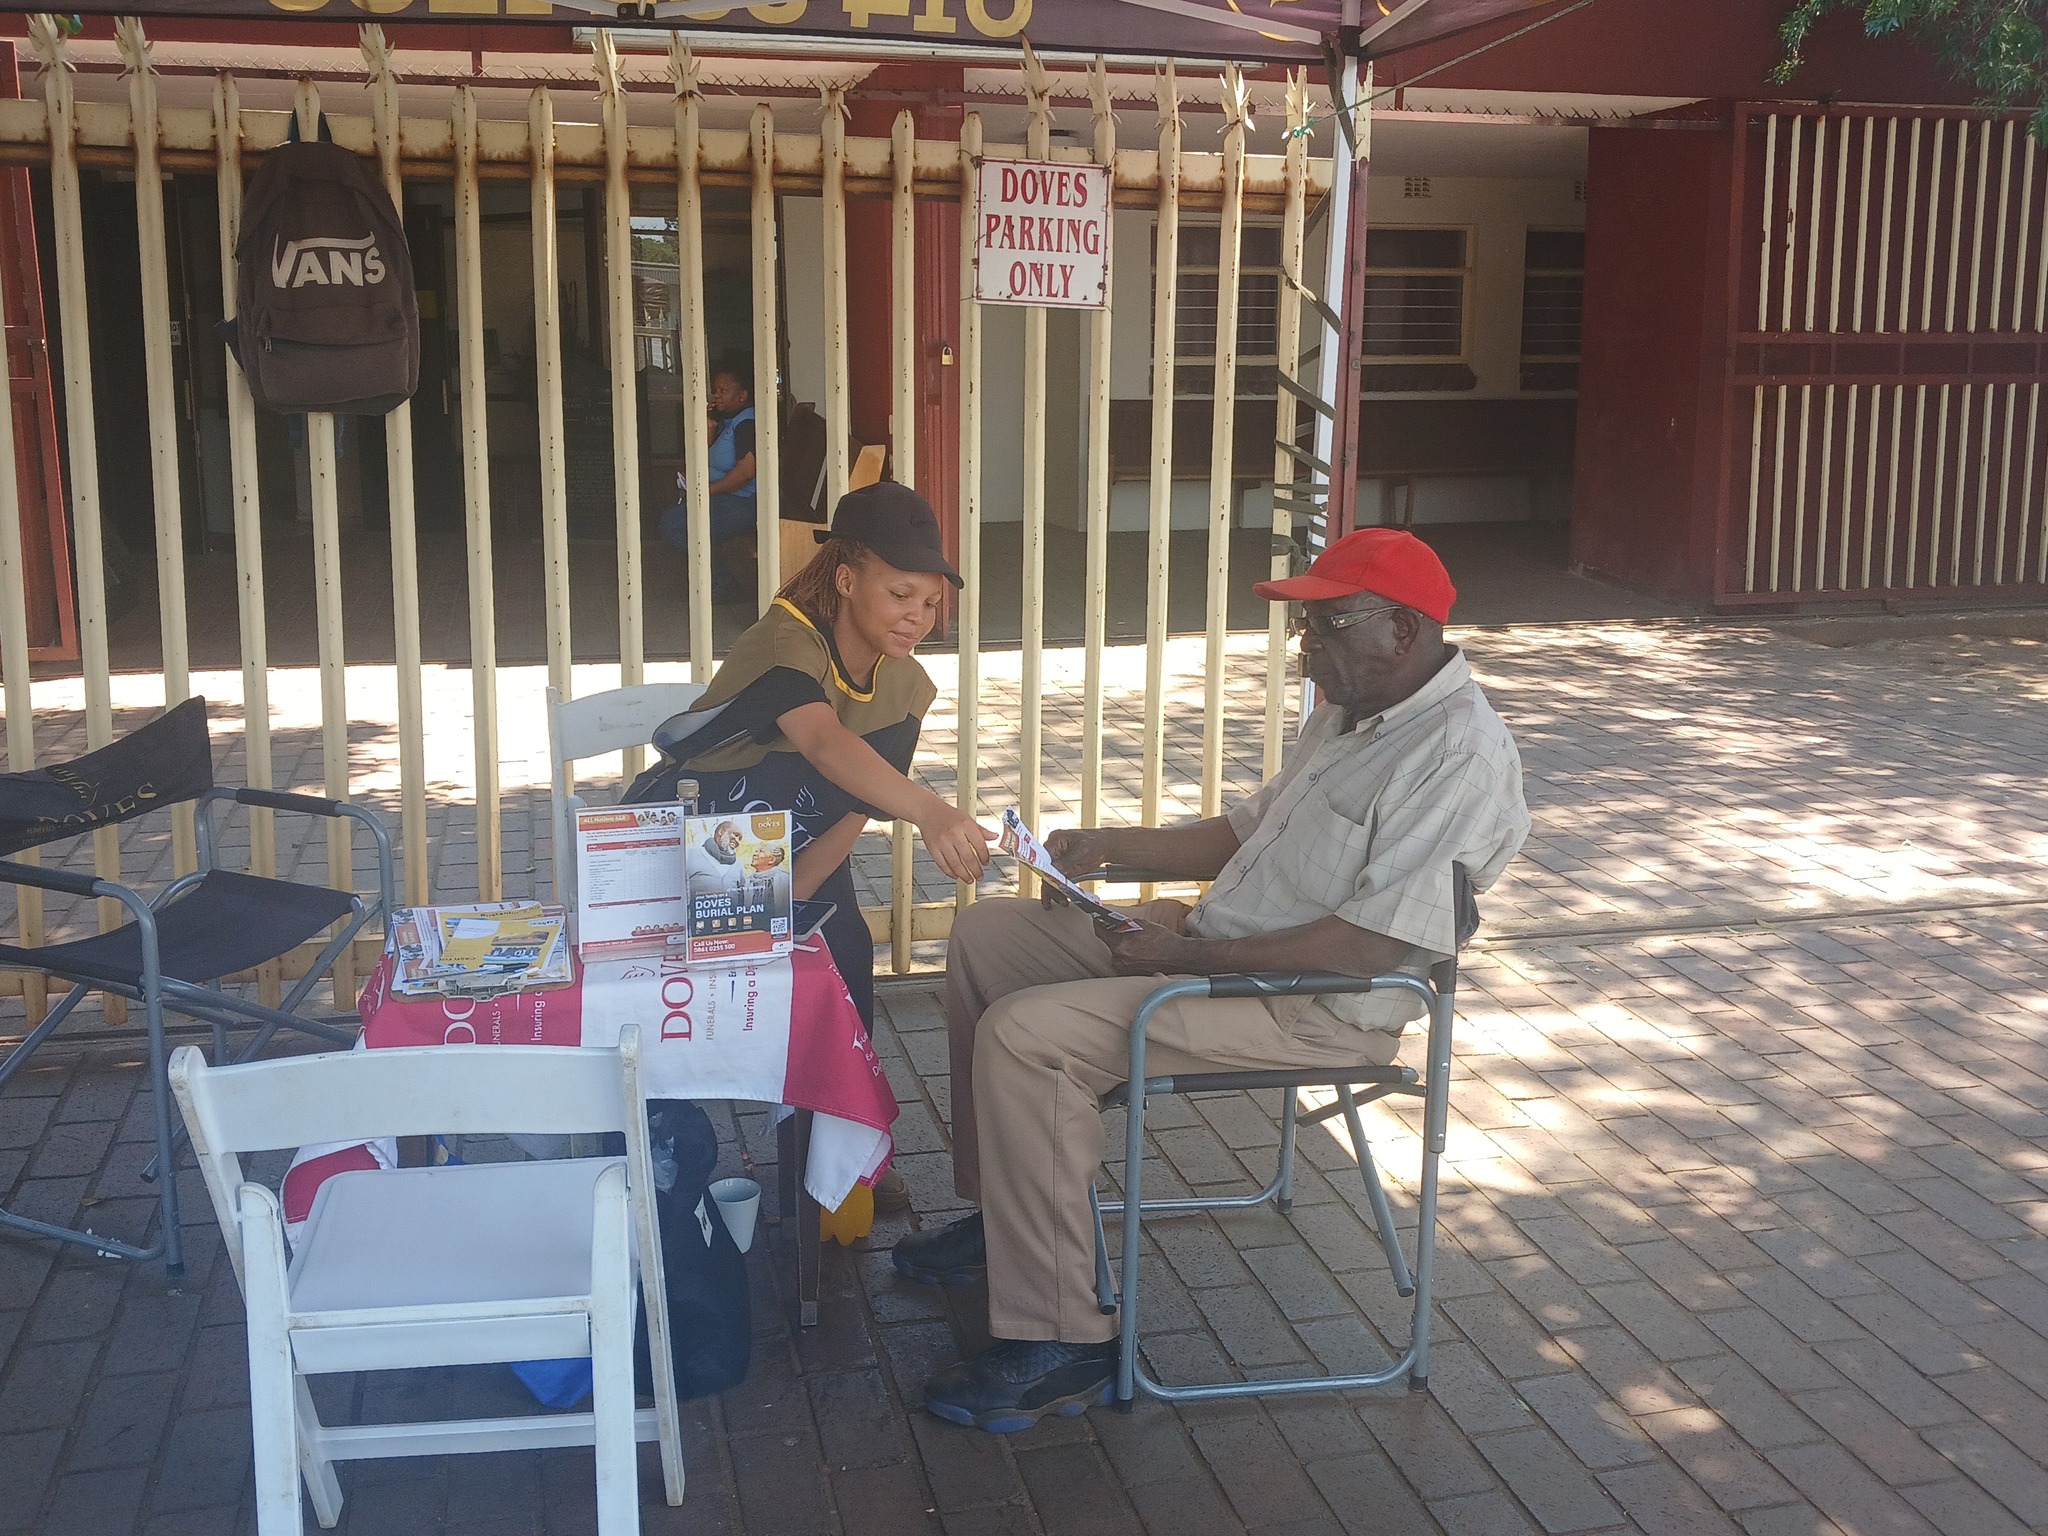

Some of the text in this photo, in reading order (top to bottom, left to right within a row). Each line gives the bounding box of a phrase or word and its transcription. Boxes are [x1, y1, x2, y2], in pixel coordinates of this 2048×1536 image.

[1001, 167, 1088, 208] DOVES
[985, 213, 1100, 255] PARKING
[271, 230, 386, 289] VANS
[1009, 261, 1075, 298] ONLY
[695, 898, 731, 909] DOVES
[695, 904, 764, 919] BURIAL PLAN
[748, 980, 756, 988] a
[530, 1000, 546, 1041] Insuring
[706, 1000, 716, 1041] FUNERALS
[742, 990, 758, 1032] Insuring
